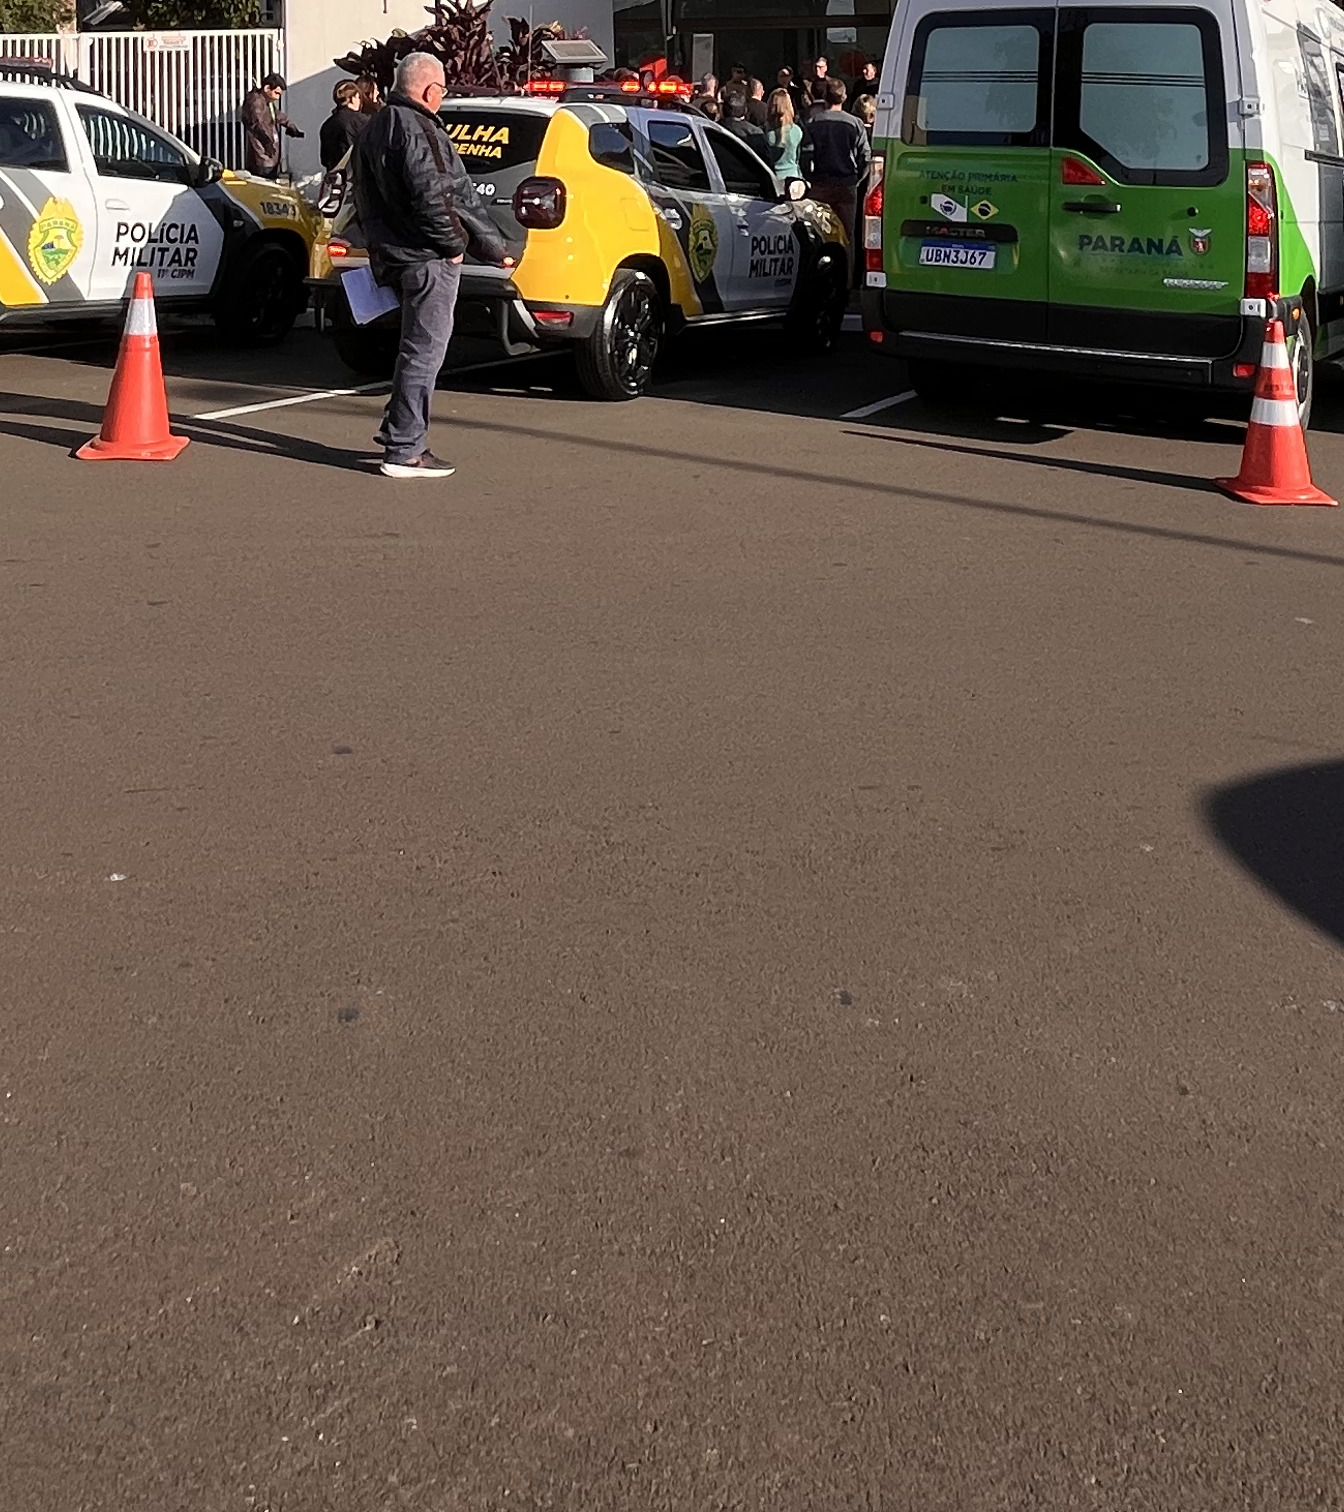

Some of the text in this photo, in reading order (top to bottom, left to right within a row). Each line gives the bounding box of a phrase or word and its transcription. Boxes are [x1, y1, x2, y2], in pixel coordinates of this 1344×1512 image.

[116, 222, 199, 245] POLÍCIA
[751, 235, 794, 256] POLÍCIA
[1078, 233, 1184, 257] PARANÁ
[112, 246, 197, 268] MILITAR
[748, 257, 795, 278] MILITAR
[925, 248, 987, 266] UBN3J67
[171, 269, 195, 279] CIPM
